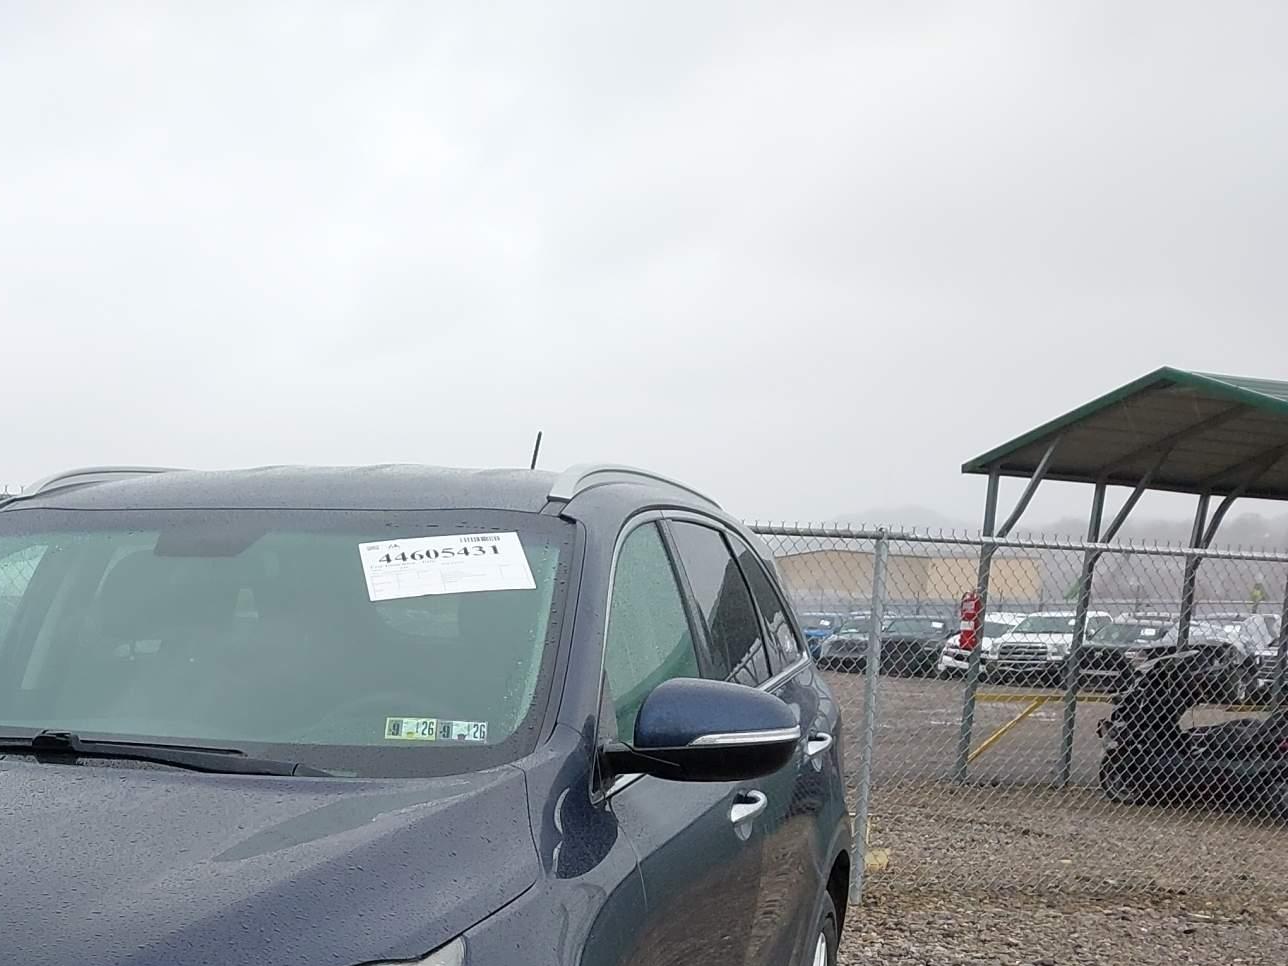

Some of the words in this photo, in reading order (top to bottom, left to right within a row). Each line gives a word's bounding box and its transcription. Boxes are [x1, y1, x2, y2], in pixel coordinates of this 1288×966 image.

[378, 544, 500, 564] 44605431
[421, 721, 435, 736] 26
[473, 724, 486, 739] 26
